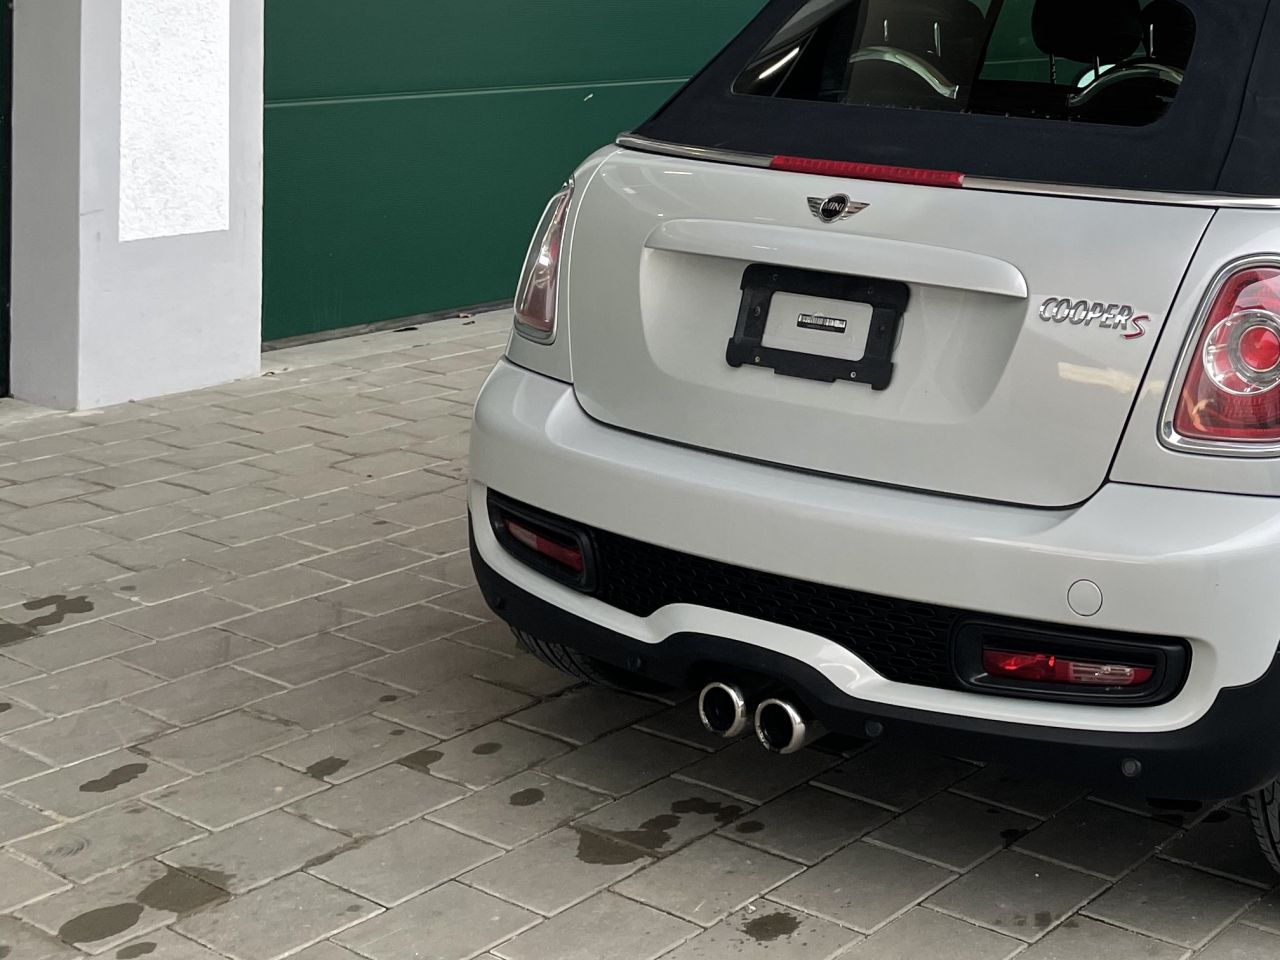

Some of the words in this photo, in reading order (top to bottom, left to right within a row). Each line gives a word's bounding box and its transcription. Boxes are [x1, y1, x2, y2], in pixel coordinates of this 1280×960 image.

[823, 201, 844, 211] MINI
[1039, 297, 1133, 330] COOPER
[1122, 315, 1150, 339] S
